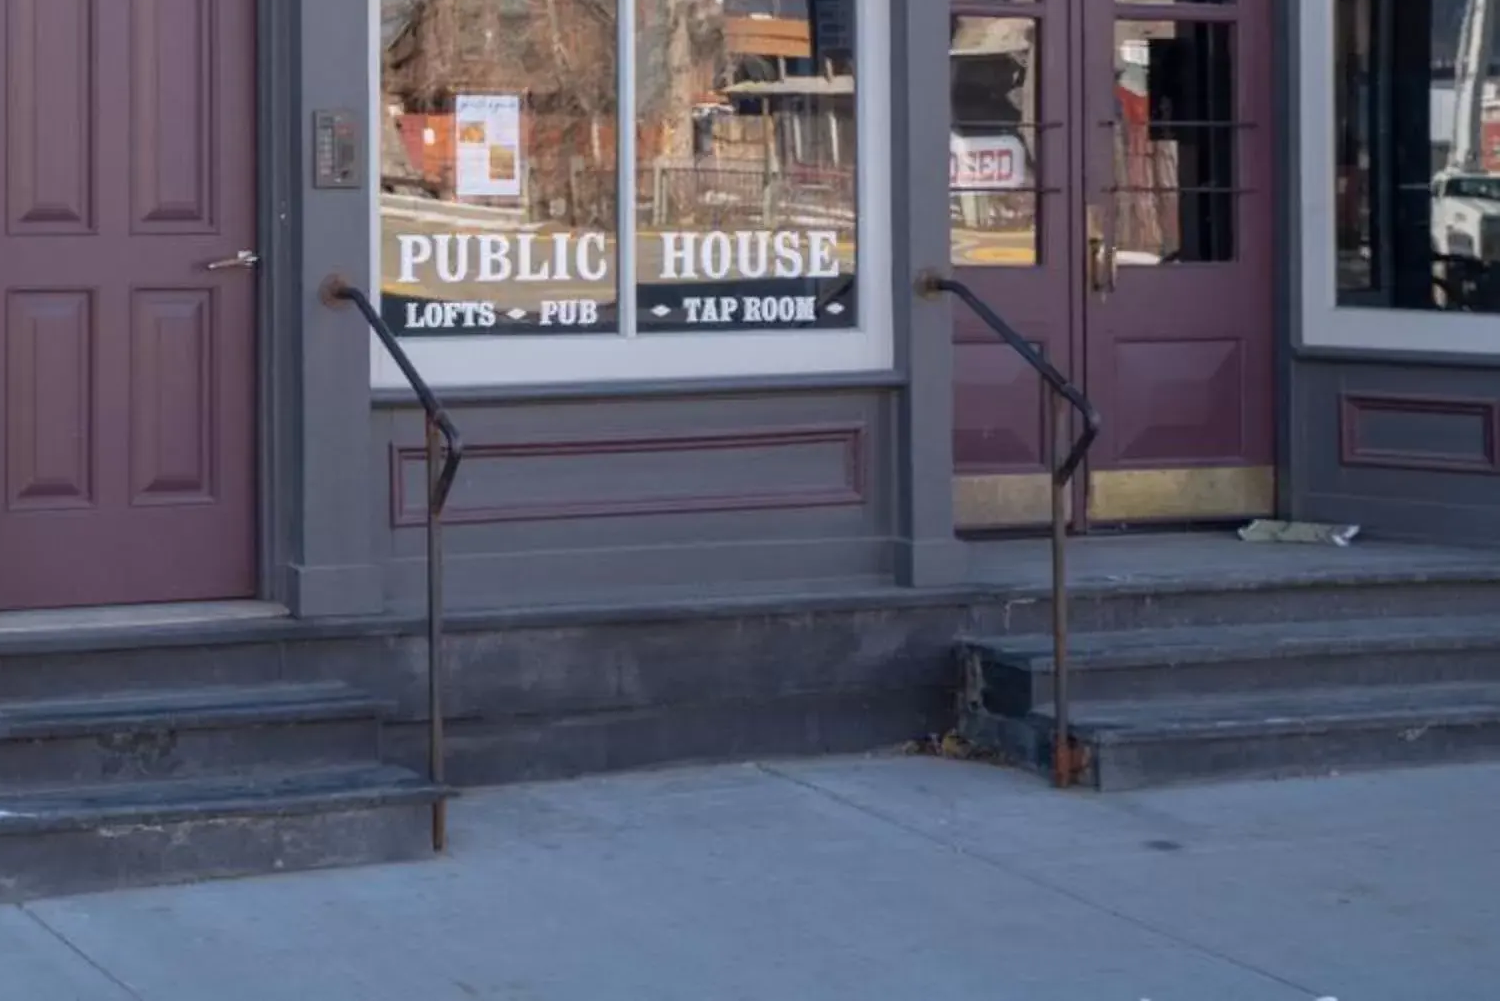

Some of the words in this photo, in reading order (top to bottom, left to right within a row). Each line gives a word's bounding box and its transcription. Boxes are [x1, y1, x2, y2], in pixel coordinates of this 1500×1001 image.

[396, 232, 607, 283] PUBLIC
[659, 230, 841, 279] HOUSE
[405, 301, 496, 328] LOFTS
[539, 300, 599, 326] PUB
[684, 297, 738, 323] TAP
[743, 295, 816, 322] ROOM
